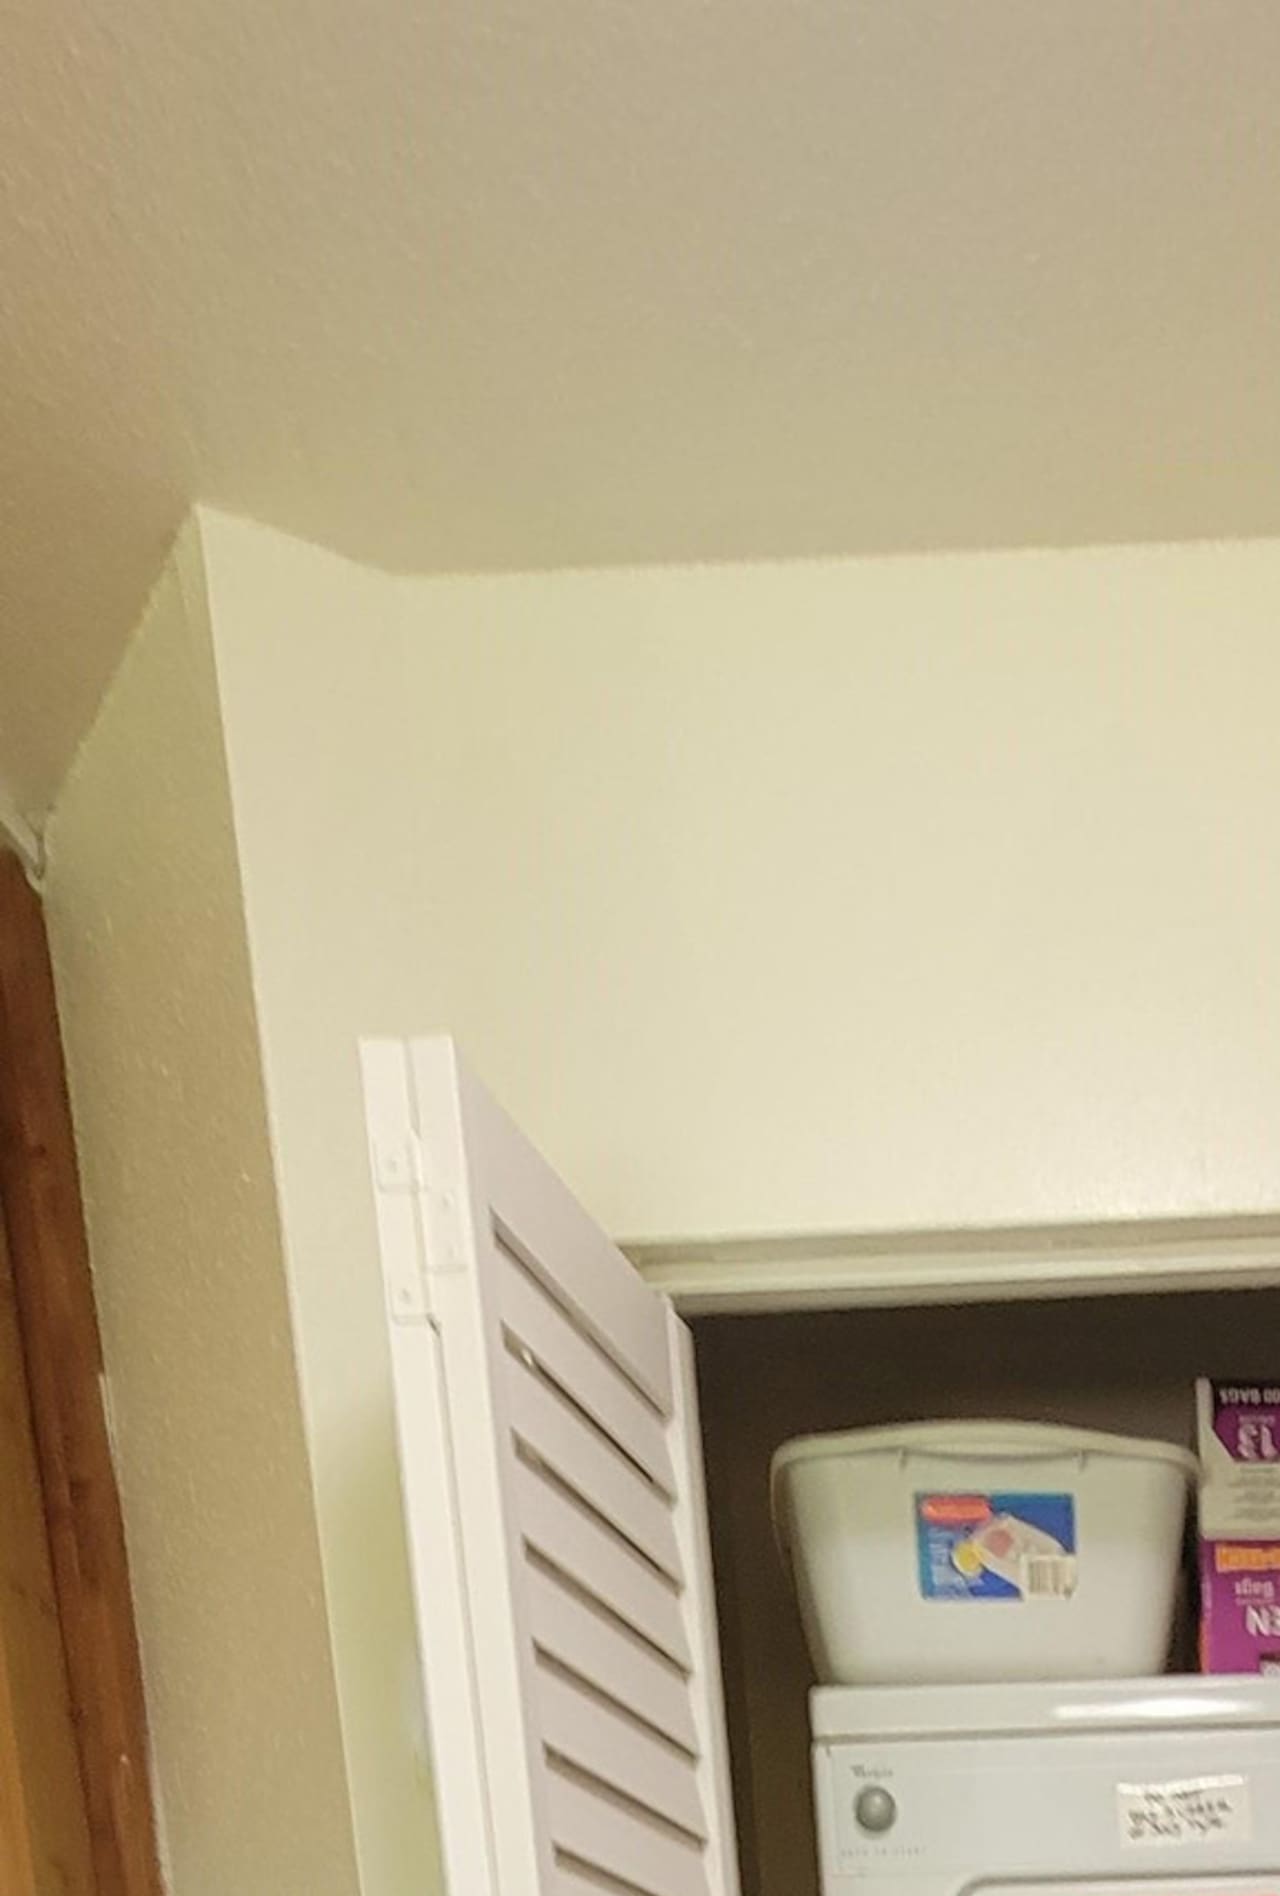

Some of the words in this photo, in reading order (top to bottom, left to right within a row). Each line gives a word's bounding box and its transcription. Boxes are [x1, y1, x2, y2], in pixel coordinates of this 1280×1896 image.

[1219, 1387, 1261, 1404] BAGS
[1236, 1423, 1278, 1460] 13
[1234, 1577, 1275, 1599] Bags
